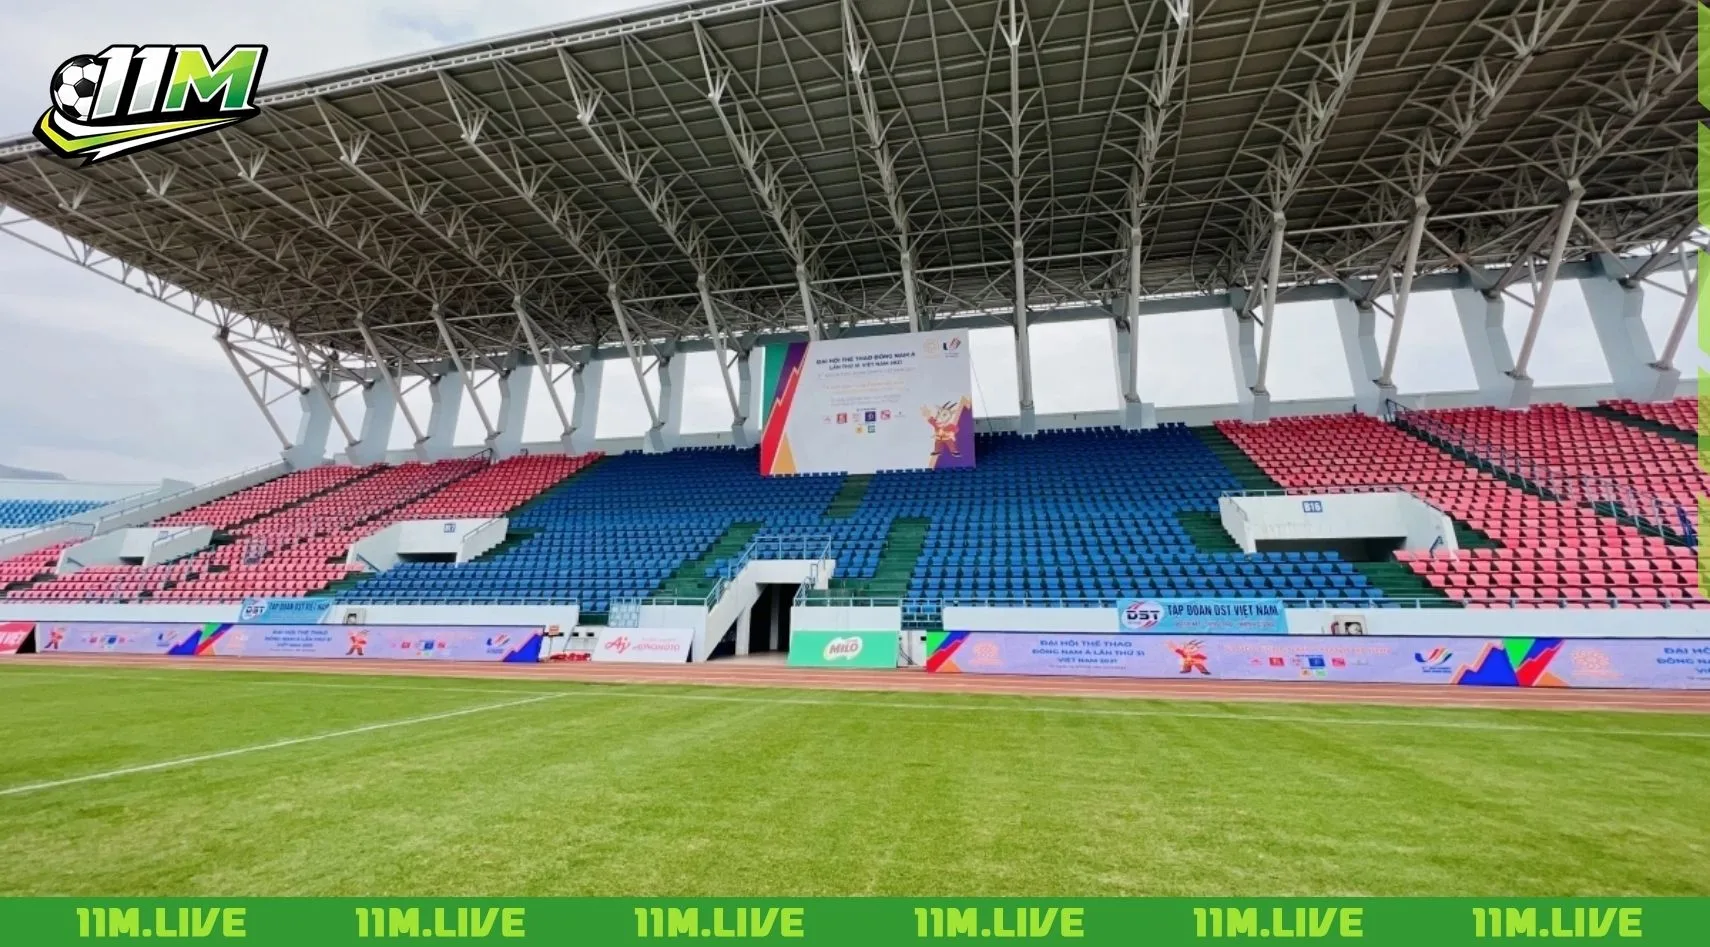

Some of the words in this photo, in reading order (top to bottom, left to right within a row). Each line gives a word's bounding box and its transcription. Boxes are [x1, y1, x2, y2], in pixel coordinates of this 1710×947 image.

[1126, 610, 1160, 620] DST
[1214, 604, 1231, 616] DST
[1256, 604, 1279, 616] NAM
[829, 642, 859, 655] MILO
